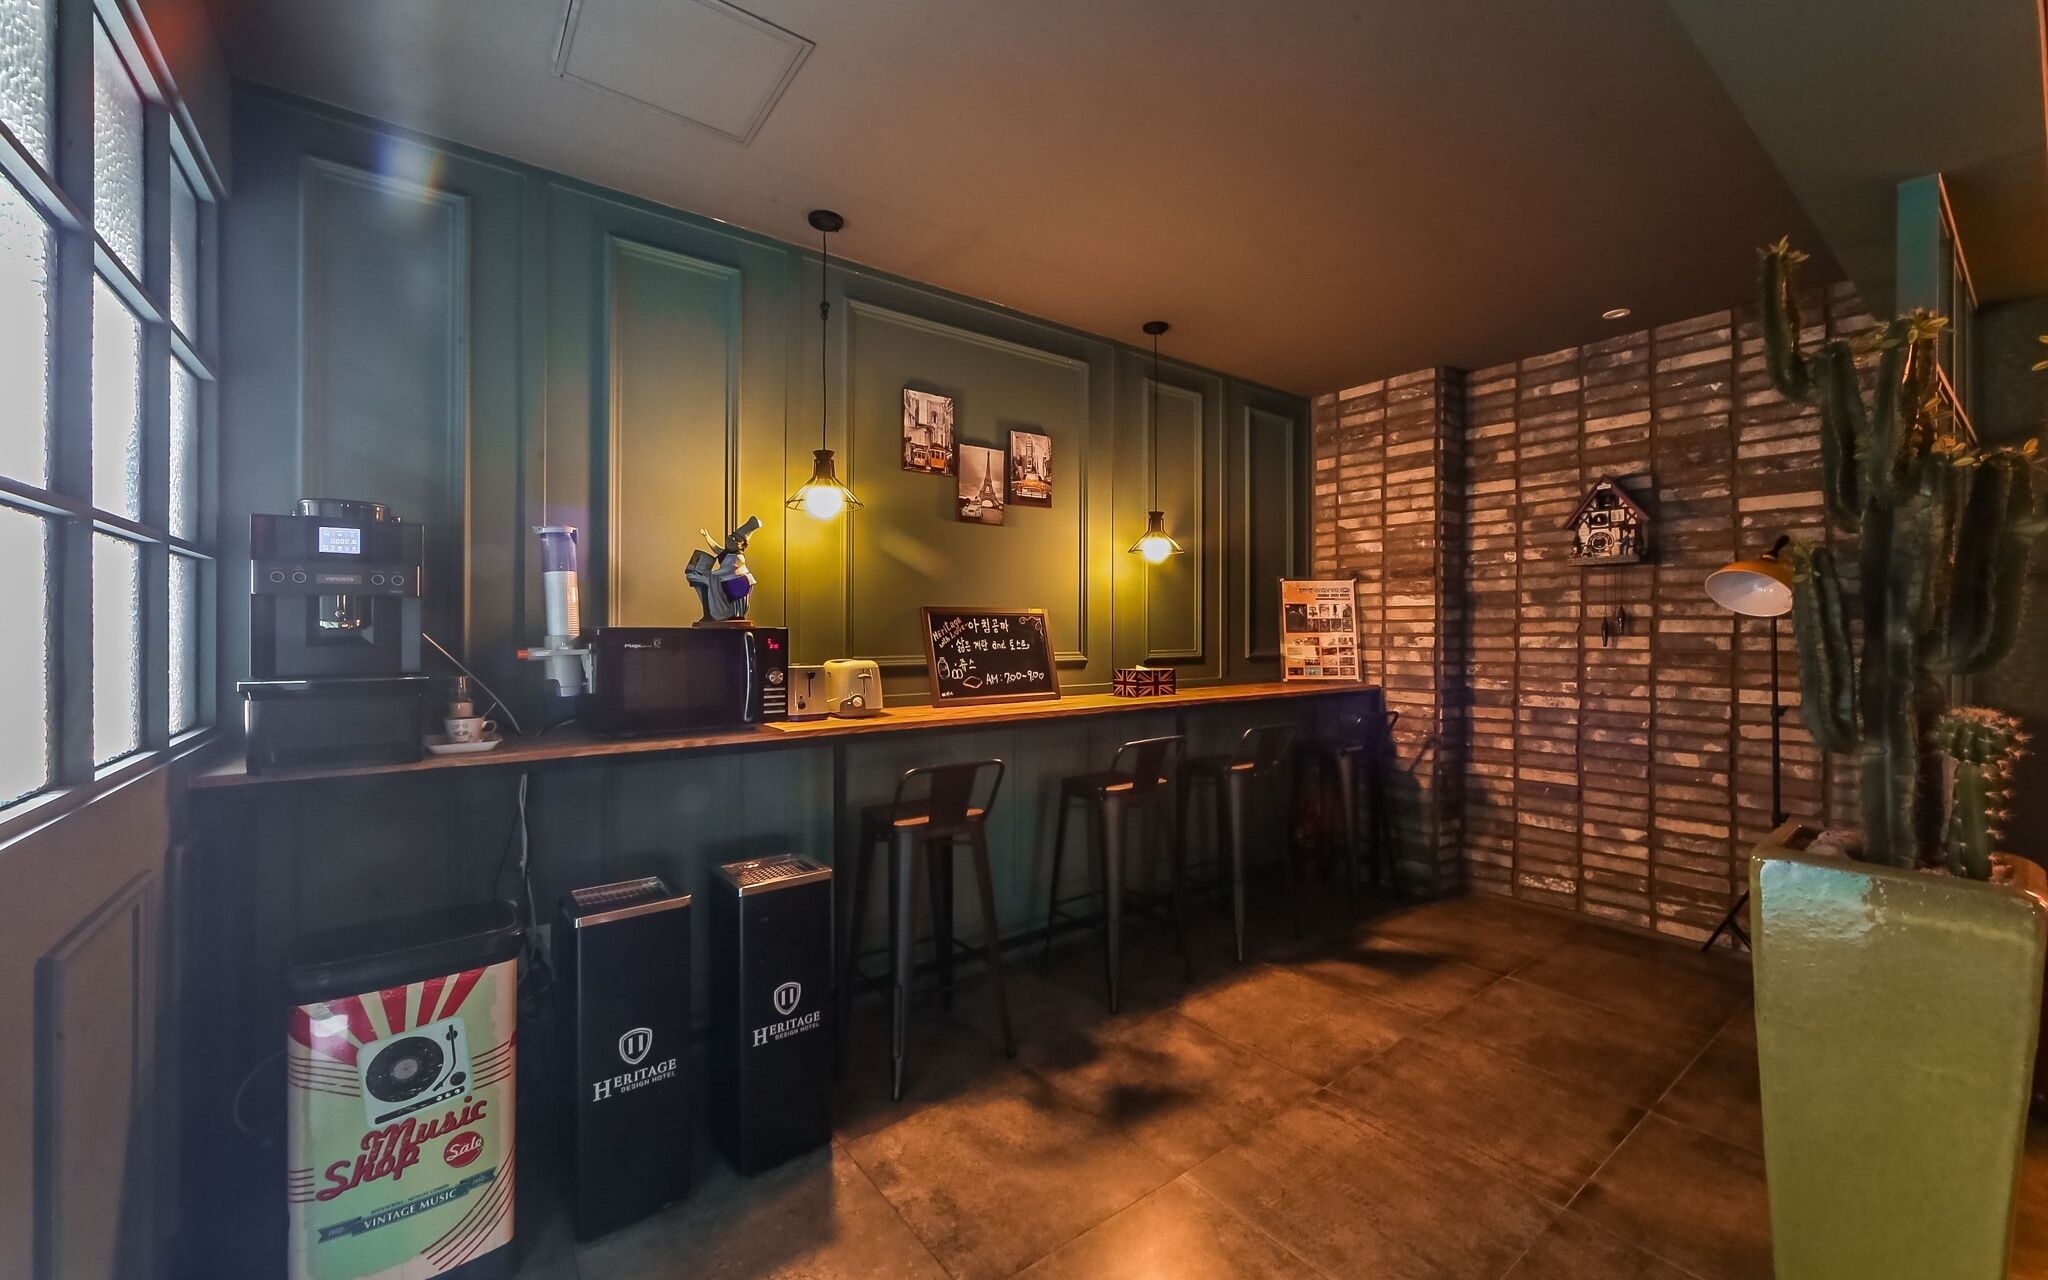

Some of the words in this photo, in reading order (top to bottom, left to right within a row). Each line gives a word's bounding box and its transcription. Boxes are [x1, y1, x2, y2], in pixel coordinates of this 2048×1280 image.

[992, 640, 1007, 650] and
[774, 1028, 799, 1040] DESIGN
[800, 1022, 820, 1032] HOTEL
[620, 1079, 650, 1093] DESIGN
[651, 1070, 676, 1083] HOTEL
[360, 1095, 488, 1162] Music
[446, 1135, 485, 1162] Sale
[315, 1142, 421, 1201] Shop
[363, 1205, 417, 1229] VINTAGE
[419, 1187, 457, 1210] MUSIC
